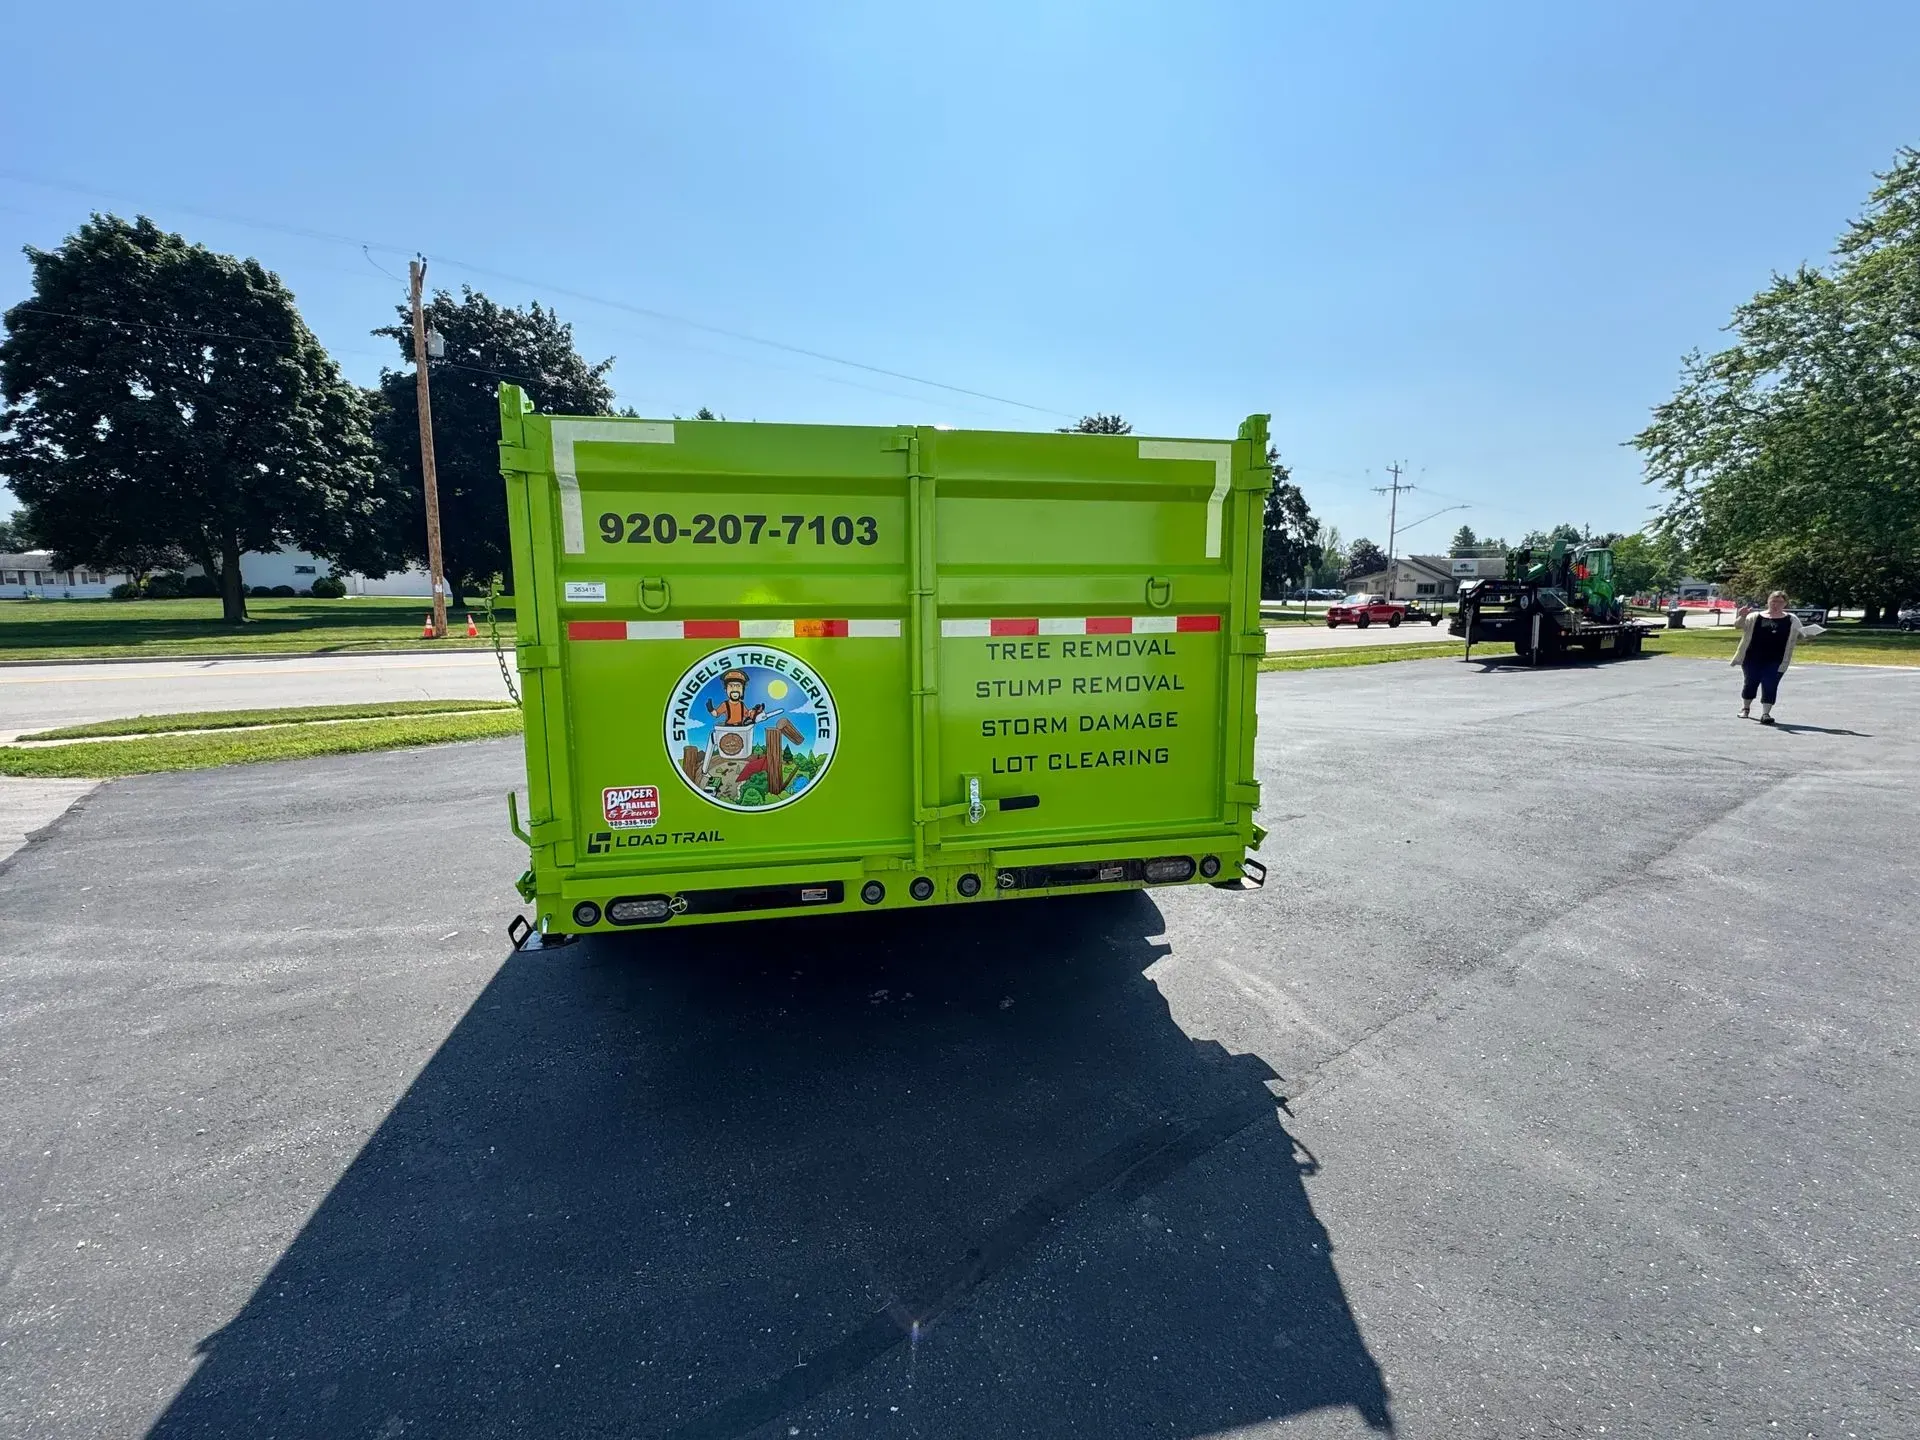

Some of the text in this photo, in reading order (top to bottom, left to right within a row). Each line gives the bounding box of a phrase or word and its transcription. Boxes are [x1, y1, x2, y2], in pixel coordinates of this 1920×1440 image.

[599, 513, 878, 545] 920-207-7103
[985, 639, 1176, 660] TREE REMOVAL
[673, 652, 830, 742] STANGEL'S TREE SERVICE
[976, 674, 1185, 698] STUMP REMOVAL
[982, 711, 1178, 737] STORM DAMAGE
[992, 748, 1169, 774] LOT CLEARING
[606, 788, 654, 810] BADGER
[620, 800, 657, 810] TRAILER
[615, 833, 668, 848] LOAD
[671, 830, 725, 845] TRAIL
